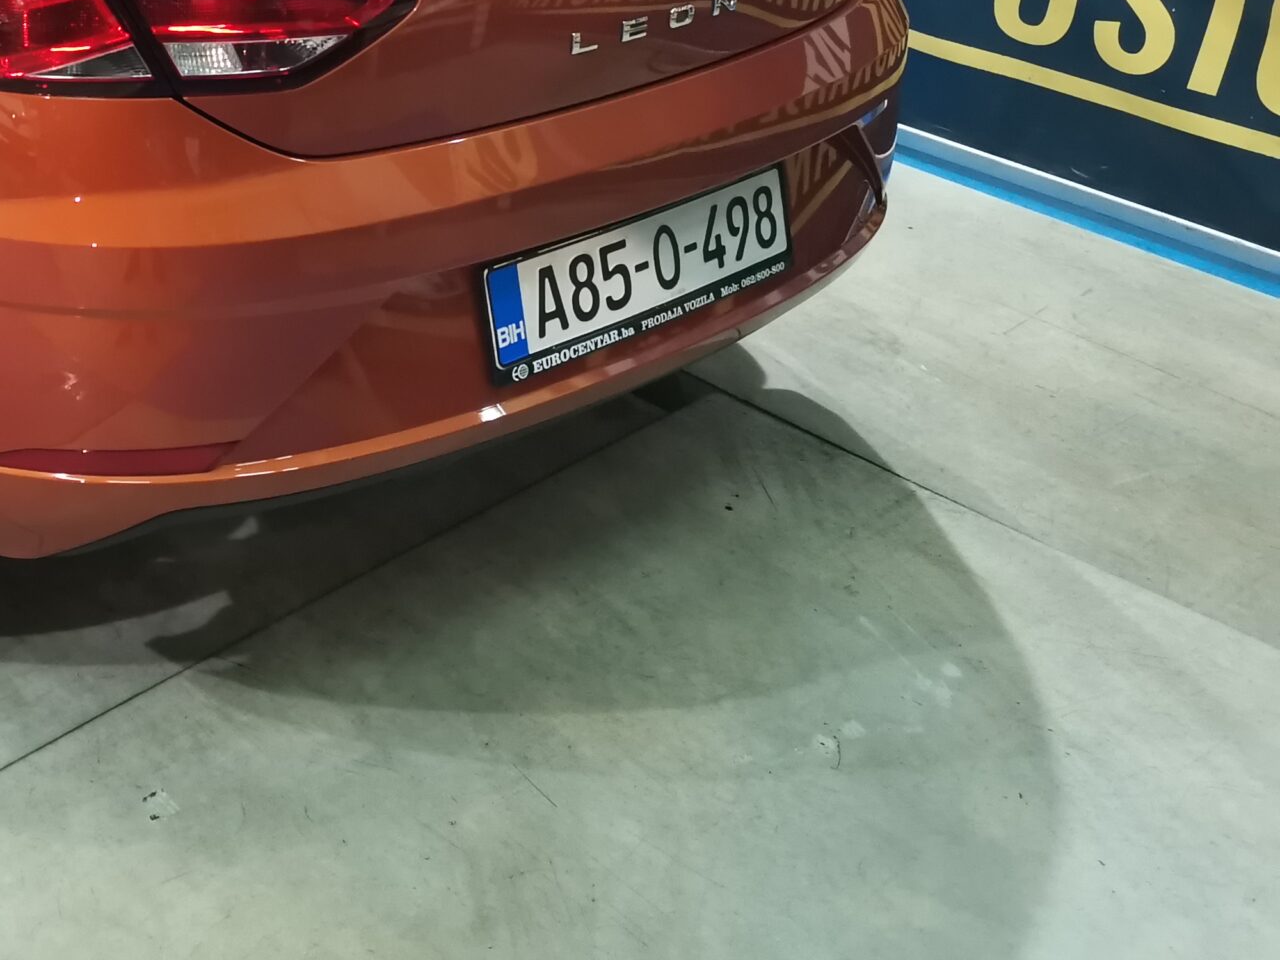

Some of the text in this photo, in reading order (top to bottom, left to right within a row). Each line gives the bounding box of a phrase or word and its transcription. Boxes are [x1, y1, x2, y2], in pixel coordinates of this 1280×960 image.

[496, 319, 527, 350] BIH
[532, 326, 636, 374] EUROCENTAR.ba
[641, 305, 683, 331] PRODAJA
[683, 292, 716, 313] VOZILA
[720, 282, 740, 298] Mob:
